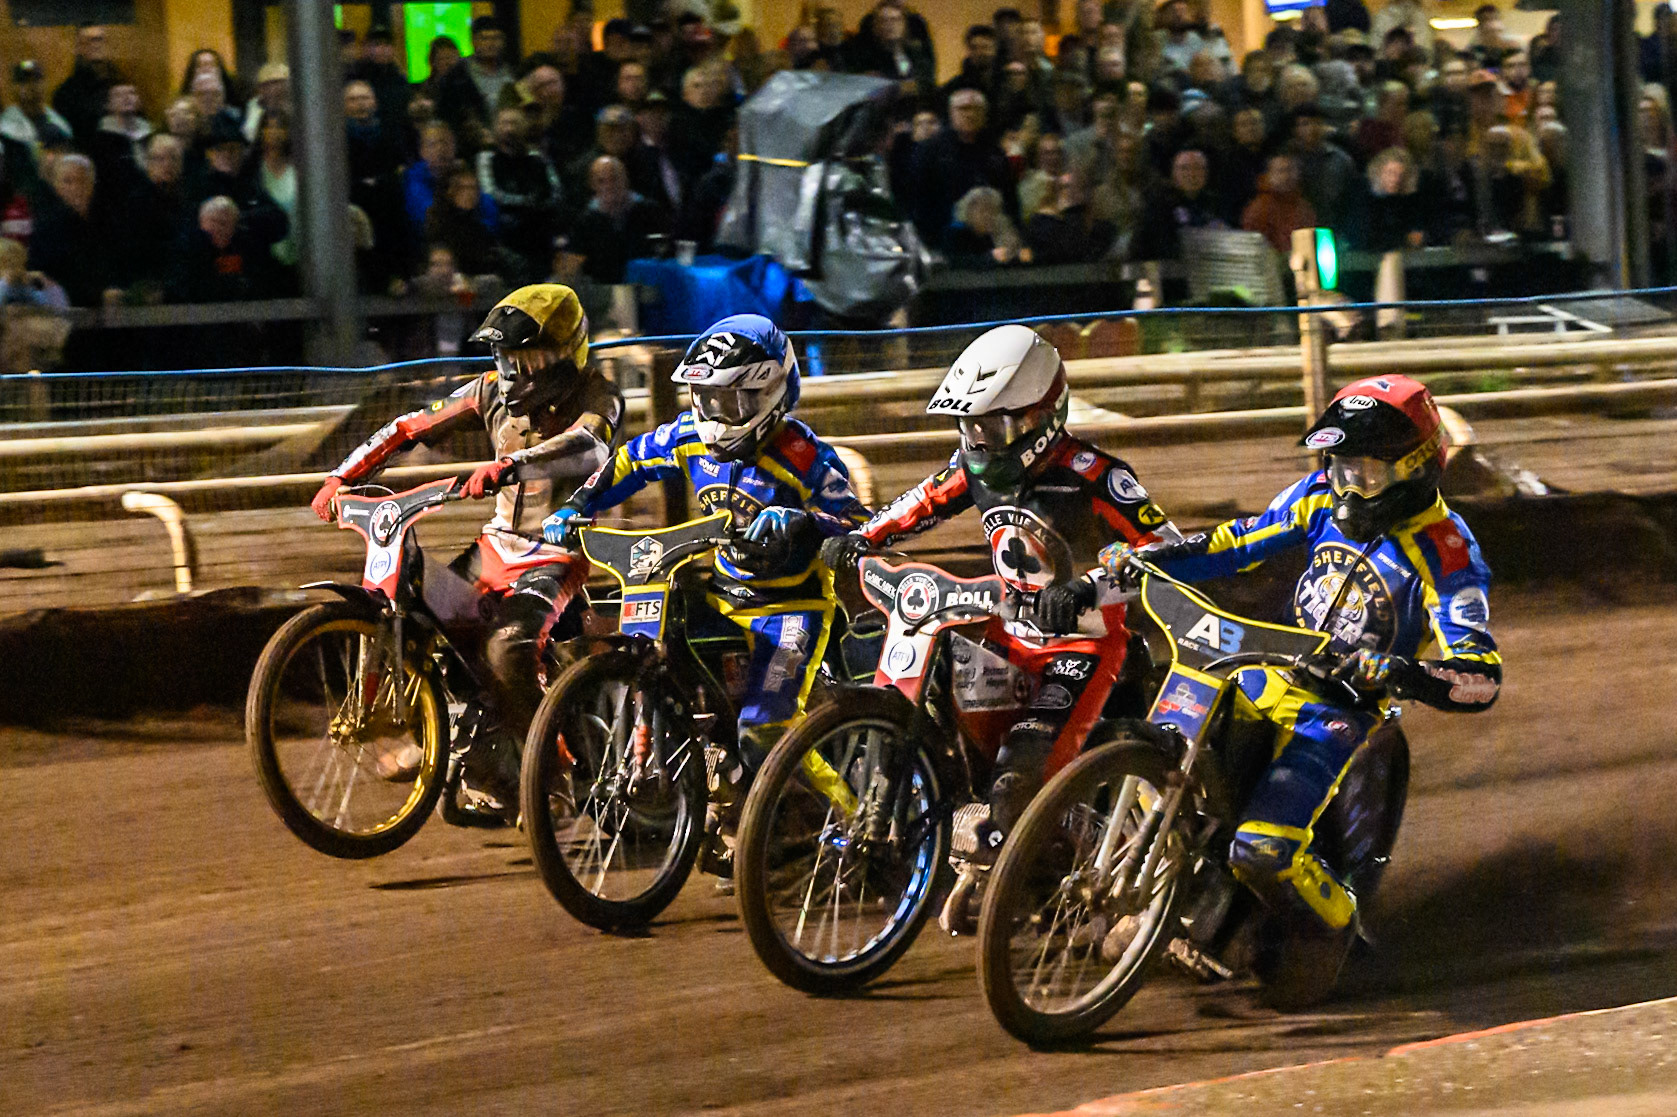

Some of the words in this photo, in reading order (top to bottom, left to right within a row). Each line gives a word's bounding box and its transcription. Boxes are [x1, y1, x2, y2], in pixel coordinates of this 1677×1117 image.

[928, 398, 973, 414] BOLL
[699, 490, 757, 512] SHEFFIE
[1313, 550, 1389, 622] SHEFFIELD
[635, 600, 661, 617] FTS
[945, 591, 993, 607] BOLL
[1185, 613, 1245, 654] AB
